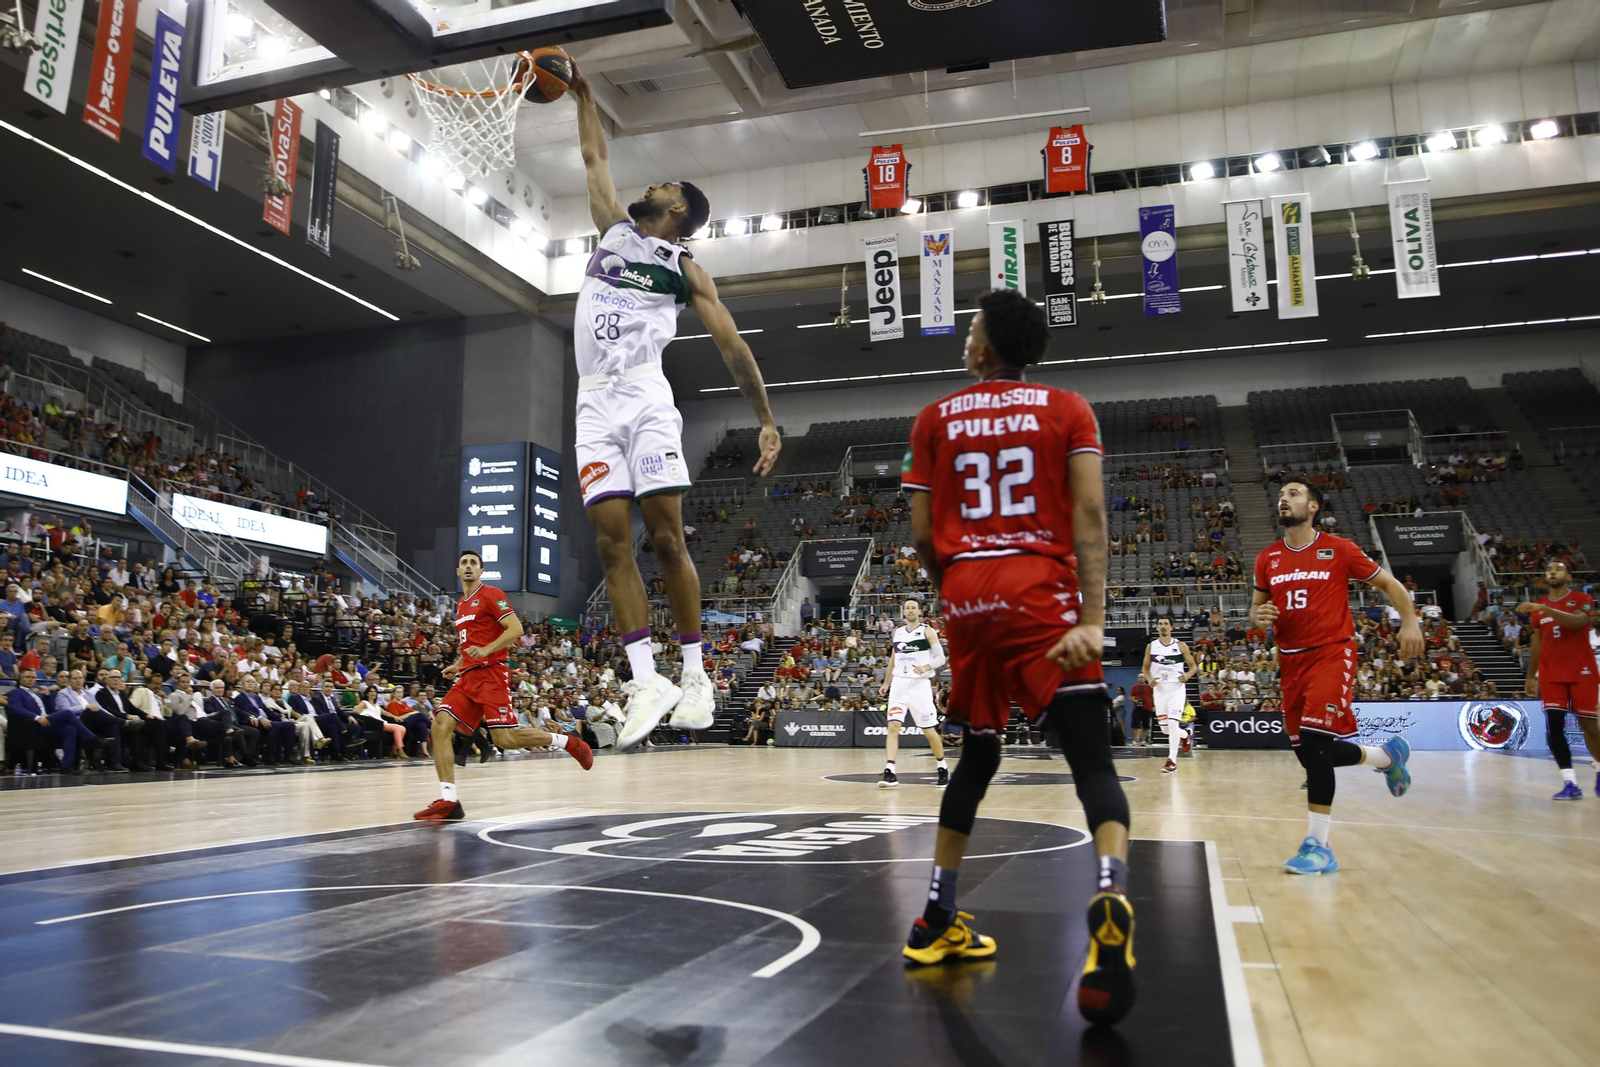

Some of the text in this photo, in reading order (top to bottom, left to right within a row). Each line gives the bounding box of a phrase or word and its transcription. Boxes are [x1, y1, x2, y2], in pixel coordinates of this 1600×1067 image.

[149, 30, 182, 160] PULEVA
[1061, 146, 1072, 165] 8
[879, 165, 895, 183] 18
[1422, 192, 1431, 220] HIERRO
[1404, 207, 1424, 271] OLIVA
[1425, 221, 1432, 231] EN
[1048, 223, 1060, 273] DE VERDAD
[1058, 222, 1074, 286] BURGERS
[1148, 240, 1170, 249] OYA
[1288, 227, 1299, 254] gruas
[620, 268, 653, 287] Unicaja
[870, 250, 897, 325] Jeep
[932, 259, 943, 323] MANZANO
[1291, 256, 1303, 305] ALHAMBRA
[594, 313, 621, 340] 28
[939, 388, 1049, 418] THOMASSON
[947, 414, 1040, 440] PULEVA
[5, 466, 49, 487] IDEA
[954, 445, 1037, 520] 32
[237, 517, 266, 533] IDEA
[1285, 589, 1309, 610] 15
[1552, 625, 1561, 638] 5
[863, 726, 924, 736] COVRAN
